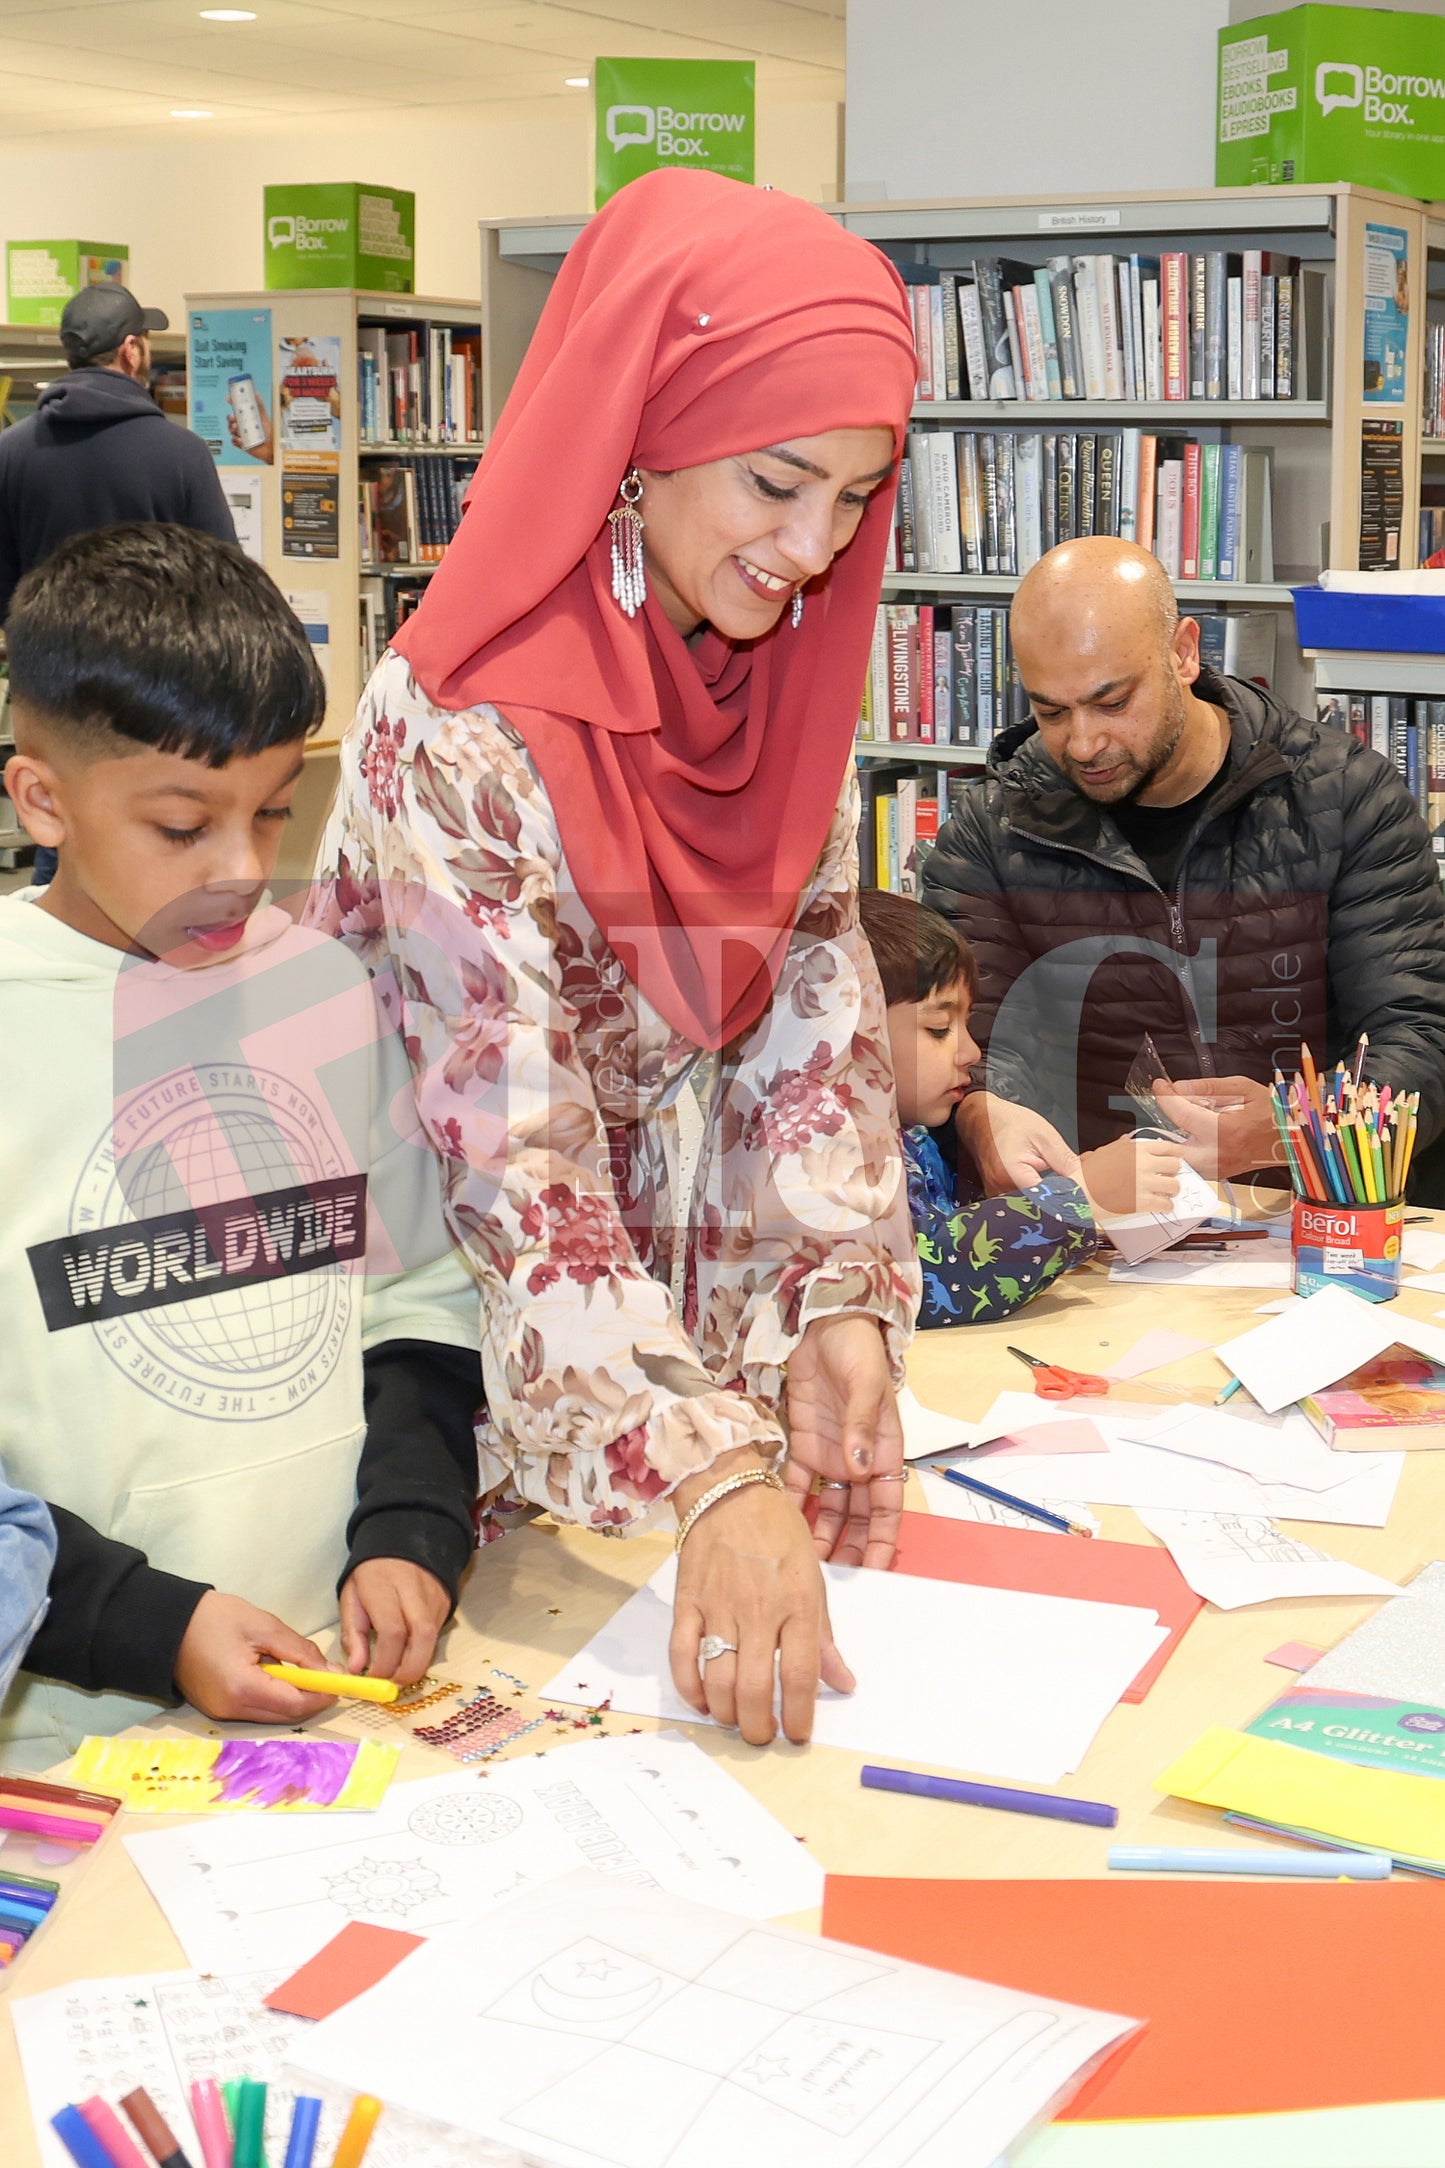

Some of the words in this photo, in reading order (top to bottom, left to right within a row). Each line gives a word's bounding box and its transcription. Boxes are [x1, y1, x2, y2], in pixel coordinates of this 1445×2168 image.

[1223, 52, 1287, 82] BESTSELLING
[1365, 65, 1445, 99] Borrow
[1223, 79, 1263, 101] EBOOKS
[1223, 91, 1295, 119] EAUDIOBOOKS
[656, 105, 746, 133] Borrow
[1230, 115, 1268, 134] EPRESS
[1364, 95, 1415, 125] Box.
[656, 131, 710, 157] Box.
[295, 215, 349, 232] Borrow
[1079, 215, 1107, 224] History
[295, 232, 328, 251] Box.
[1168, 260, 1180, 316] ELIZABETHANS
[1057, 284, 1072, 339] SNOWDON
[212, 338, 247, 354] Smoking
[1168, 319, 1181, 353] ANDREW
[194, 356, 213, 369] Start
[215, 356, 243, 371] Saving
[1169, 354, 1181, 378] MARR
[942, 454, 950, 482] DAVID
[1080, 440, 1095, 470] Queen
[1187, 450, 1197, 476] THIS
[901, 464, 909, 483] TOM
[1100, 448, 1113, 501] QUEEN
[1187, 478, 1197, 499] BOY
[902, 484, 910, 513] BOWER
[1060, 471, 1072, 522] QUEEN
[1081, 471, 1095, 519] Elizabeth
[1168, 473, 1178, 510] BORIS
[1227, 483, 1237, 516] MISTER
[944, 485, 952, 532] CAMERON
[903, 514, 913, 552] REVENGE
[1226, 516, 1236, 557] POSTMAN
[980, 614, 993, 648] TAKING
[935, 635, 944, 669] MARR
[955, 642, 976, 677] Darling
[877, 662, 886, 689] GLORY
[893, 630, 910, 713] LIVINGSTONE
[980, 672, 992, 696] CHIN
[1374, 706, 1384, 730] OUR
[1397, 717, 1407, 743] THE
[1397, 745, 1407, 777] PLOT
[1437, 723, 1445, 779] CULLODEN
[93, 1136, 127, 1175] THE
[126, 1075, 201, 1132] FUTURE
[208, 1072, 281, 1098] STARTS
[287, 1094, 319, 1130] NOW
[325, 1157, 341, 1180] TH
[1300, 1210, 1359, 1236] Berol
[1301, 1230, 1325, 1243] Colour
[1325, 1235, 1351, 1245] Broad
[63, 1190, 358, 1310] WORLDWIDE
[319, 1300, 348, 1369] STARTS
[128, 1354, 203, 1408] FUTURE
[287, 1368, 318, 1402] NOW
[217, 1394, 257, 1413] THE
[1267, 1717, 1316, 1733] A4
[1321, 1724, 1436, 1753] Glitter
